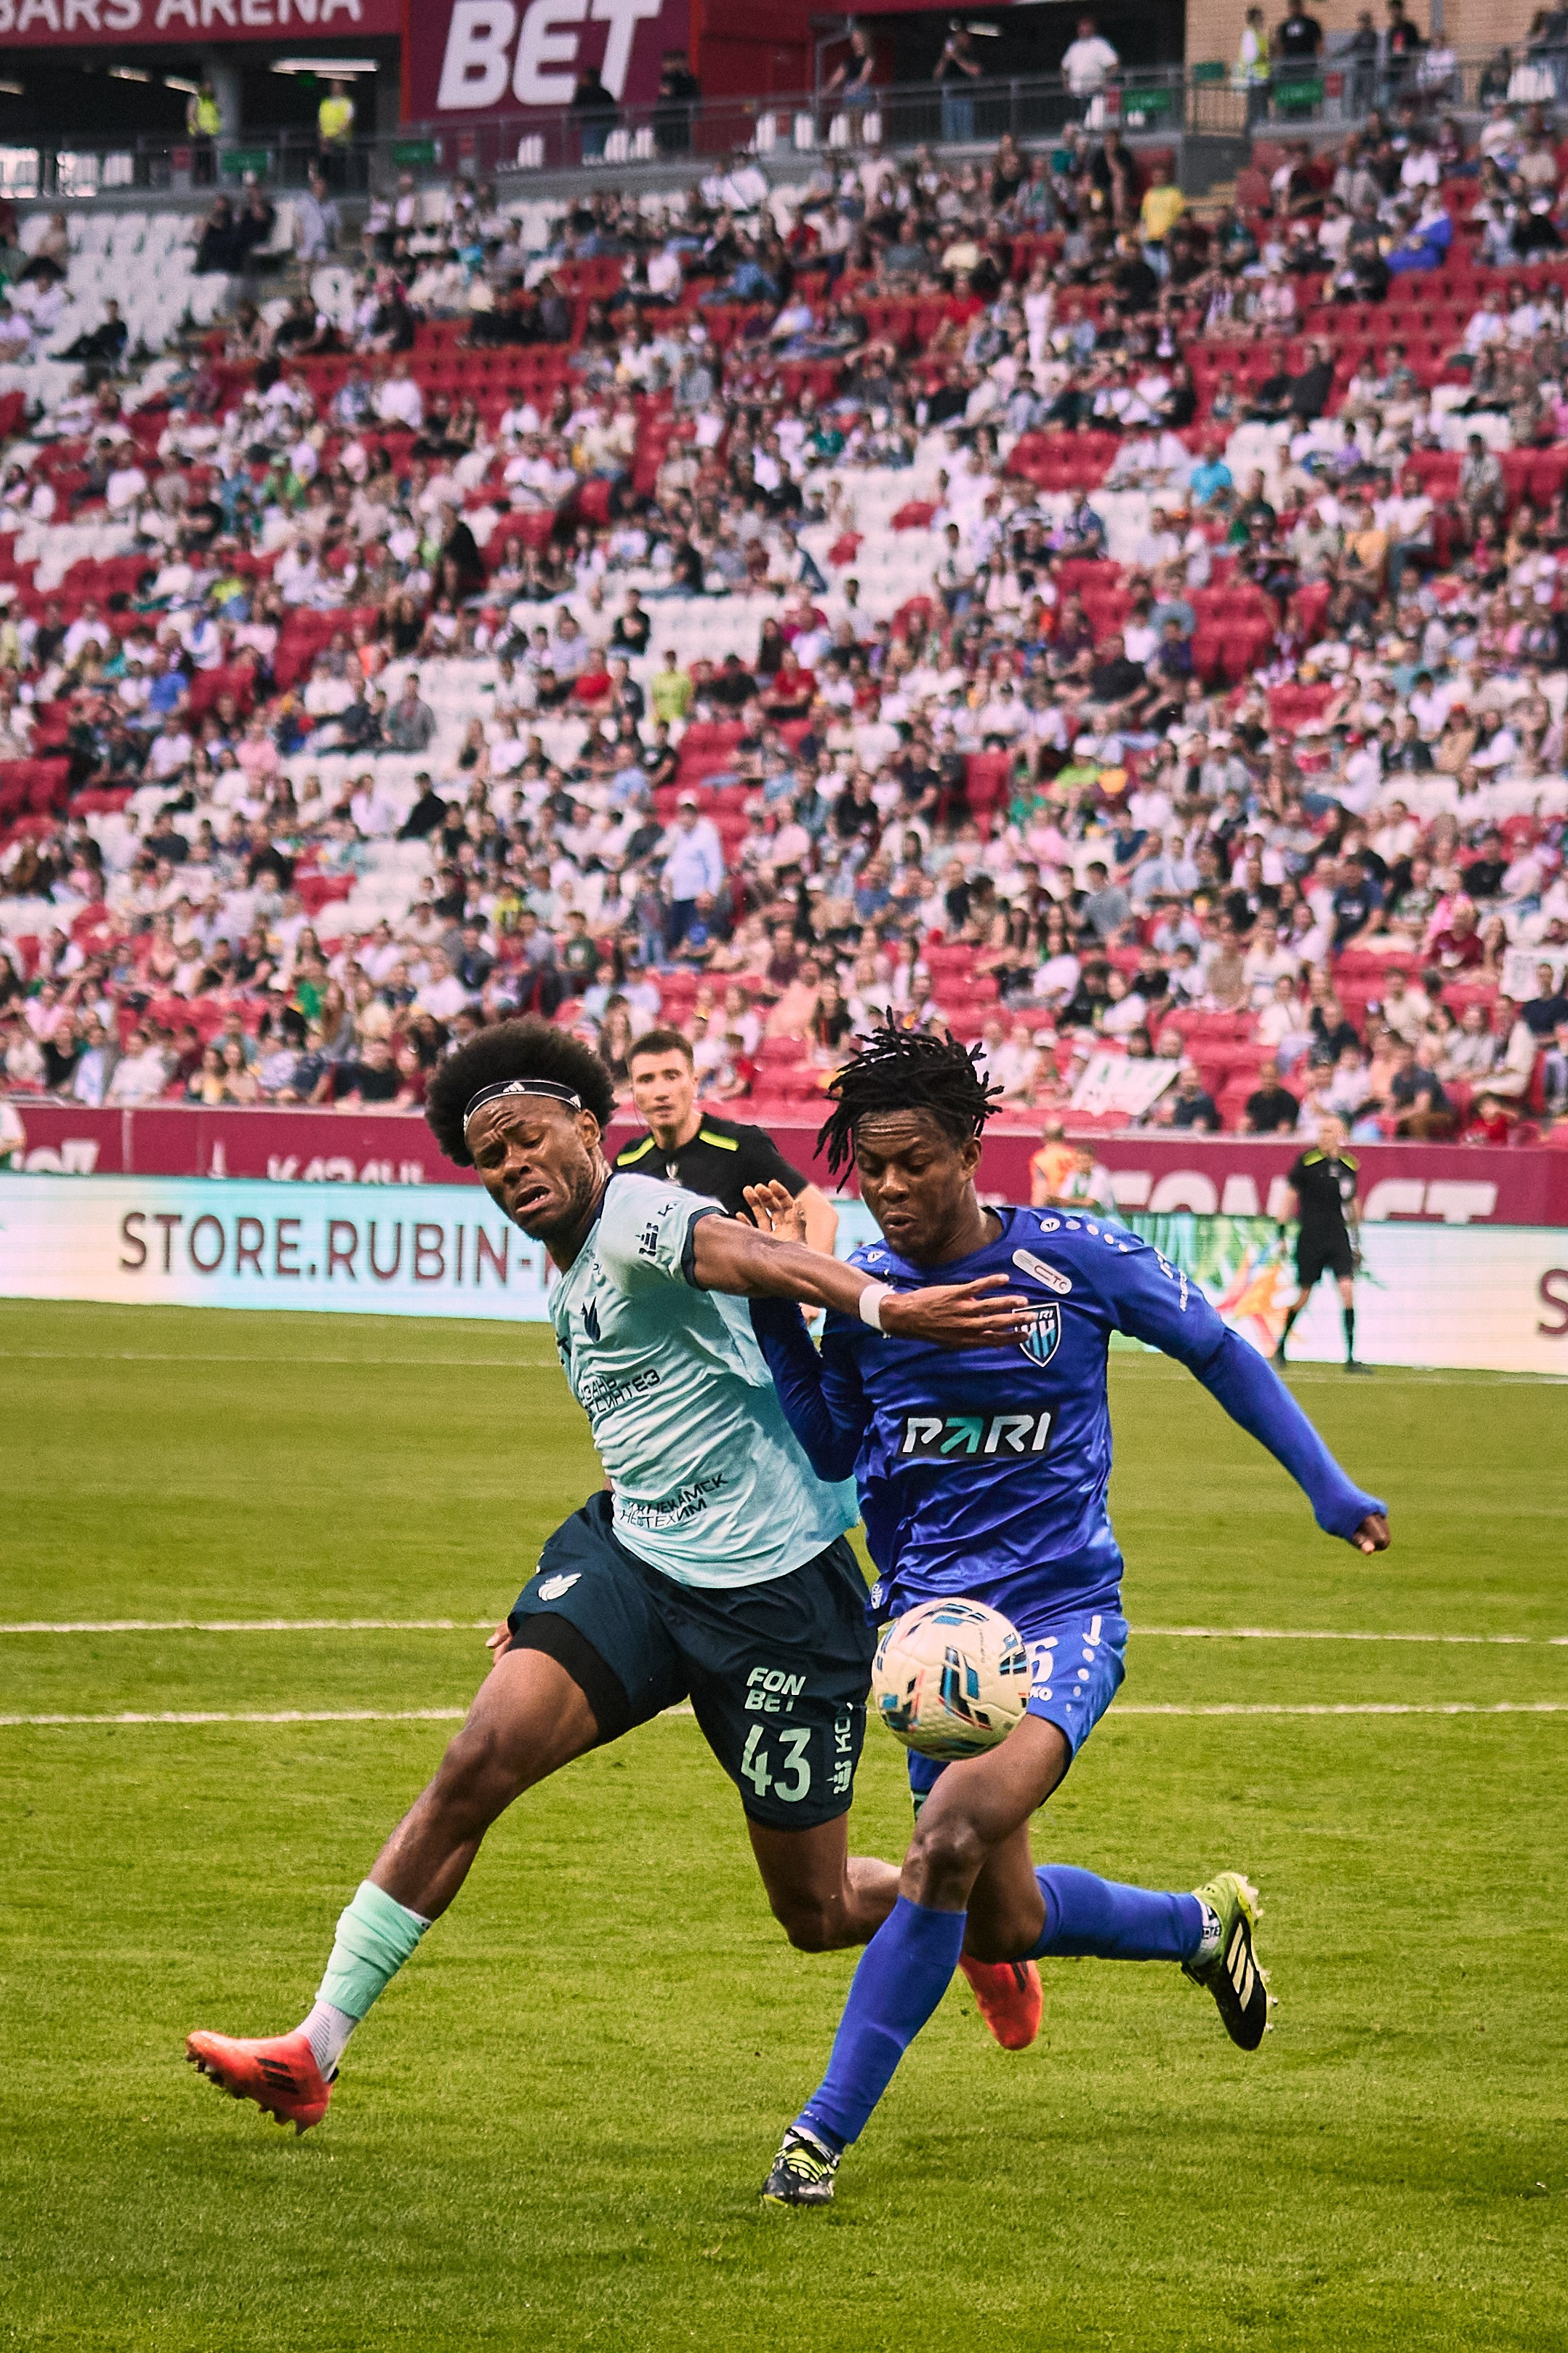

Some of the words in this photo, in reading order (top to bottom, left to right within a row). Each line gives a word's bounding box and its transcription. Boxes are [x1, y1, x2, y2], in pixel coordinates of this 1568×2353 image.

[438, 0, 663, 109] BET
[902, 1412, 1051, 1454] PARI
[746, 1667, 806, 1696] FON
[741, 1724, 811, 1803] 43
